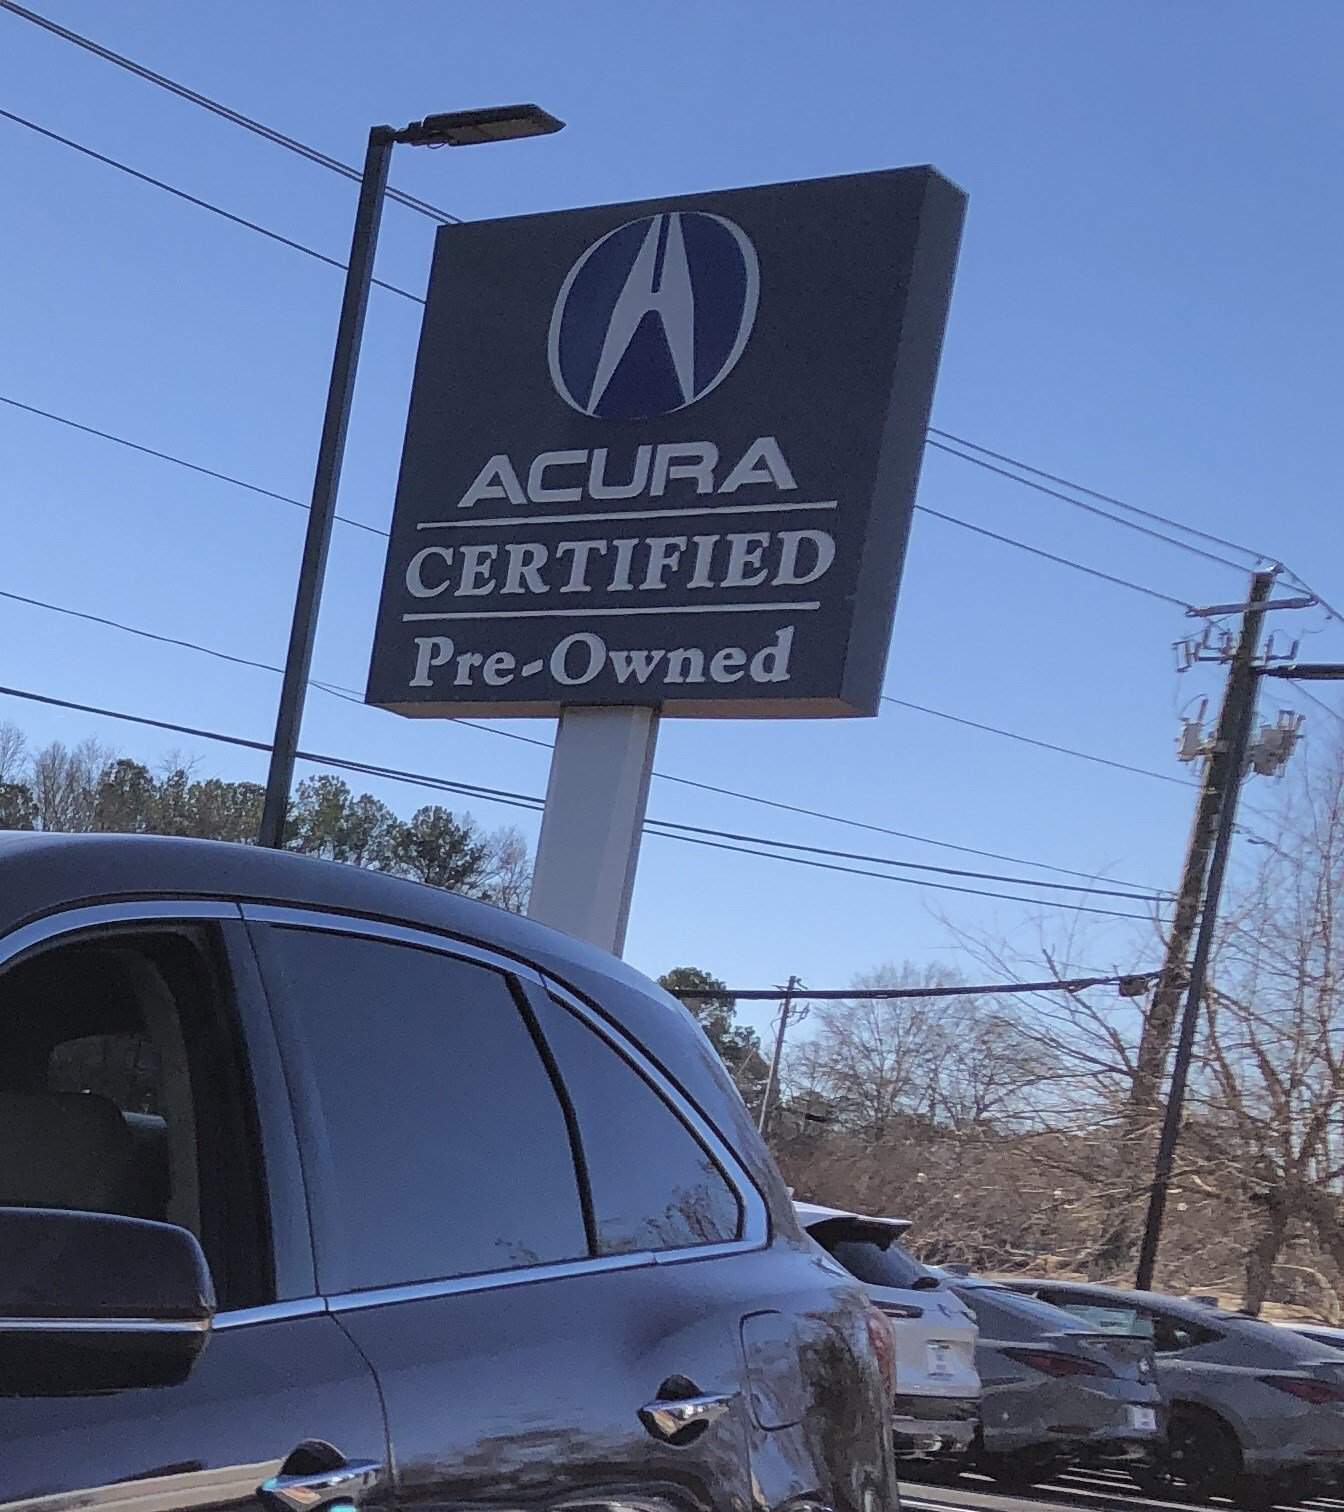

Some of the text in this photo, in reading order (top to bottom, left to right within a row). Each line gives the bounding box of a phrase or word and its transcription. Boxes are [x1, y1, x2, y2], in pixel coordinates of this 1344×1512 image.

[457, 436, 798, 508] ACURA
[405, 529, 836, 598] CERTIFIED
[409, 625, 796, 688] Pre-Owned
